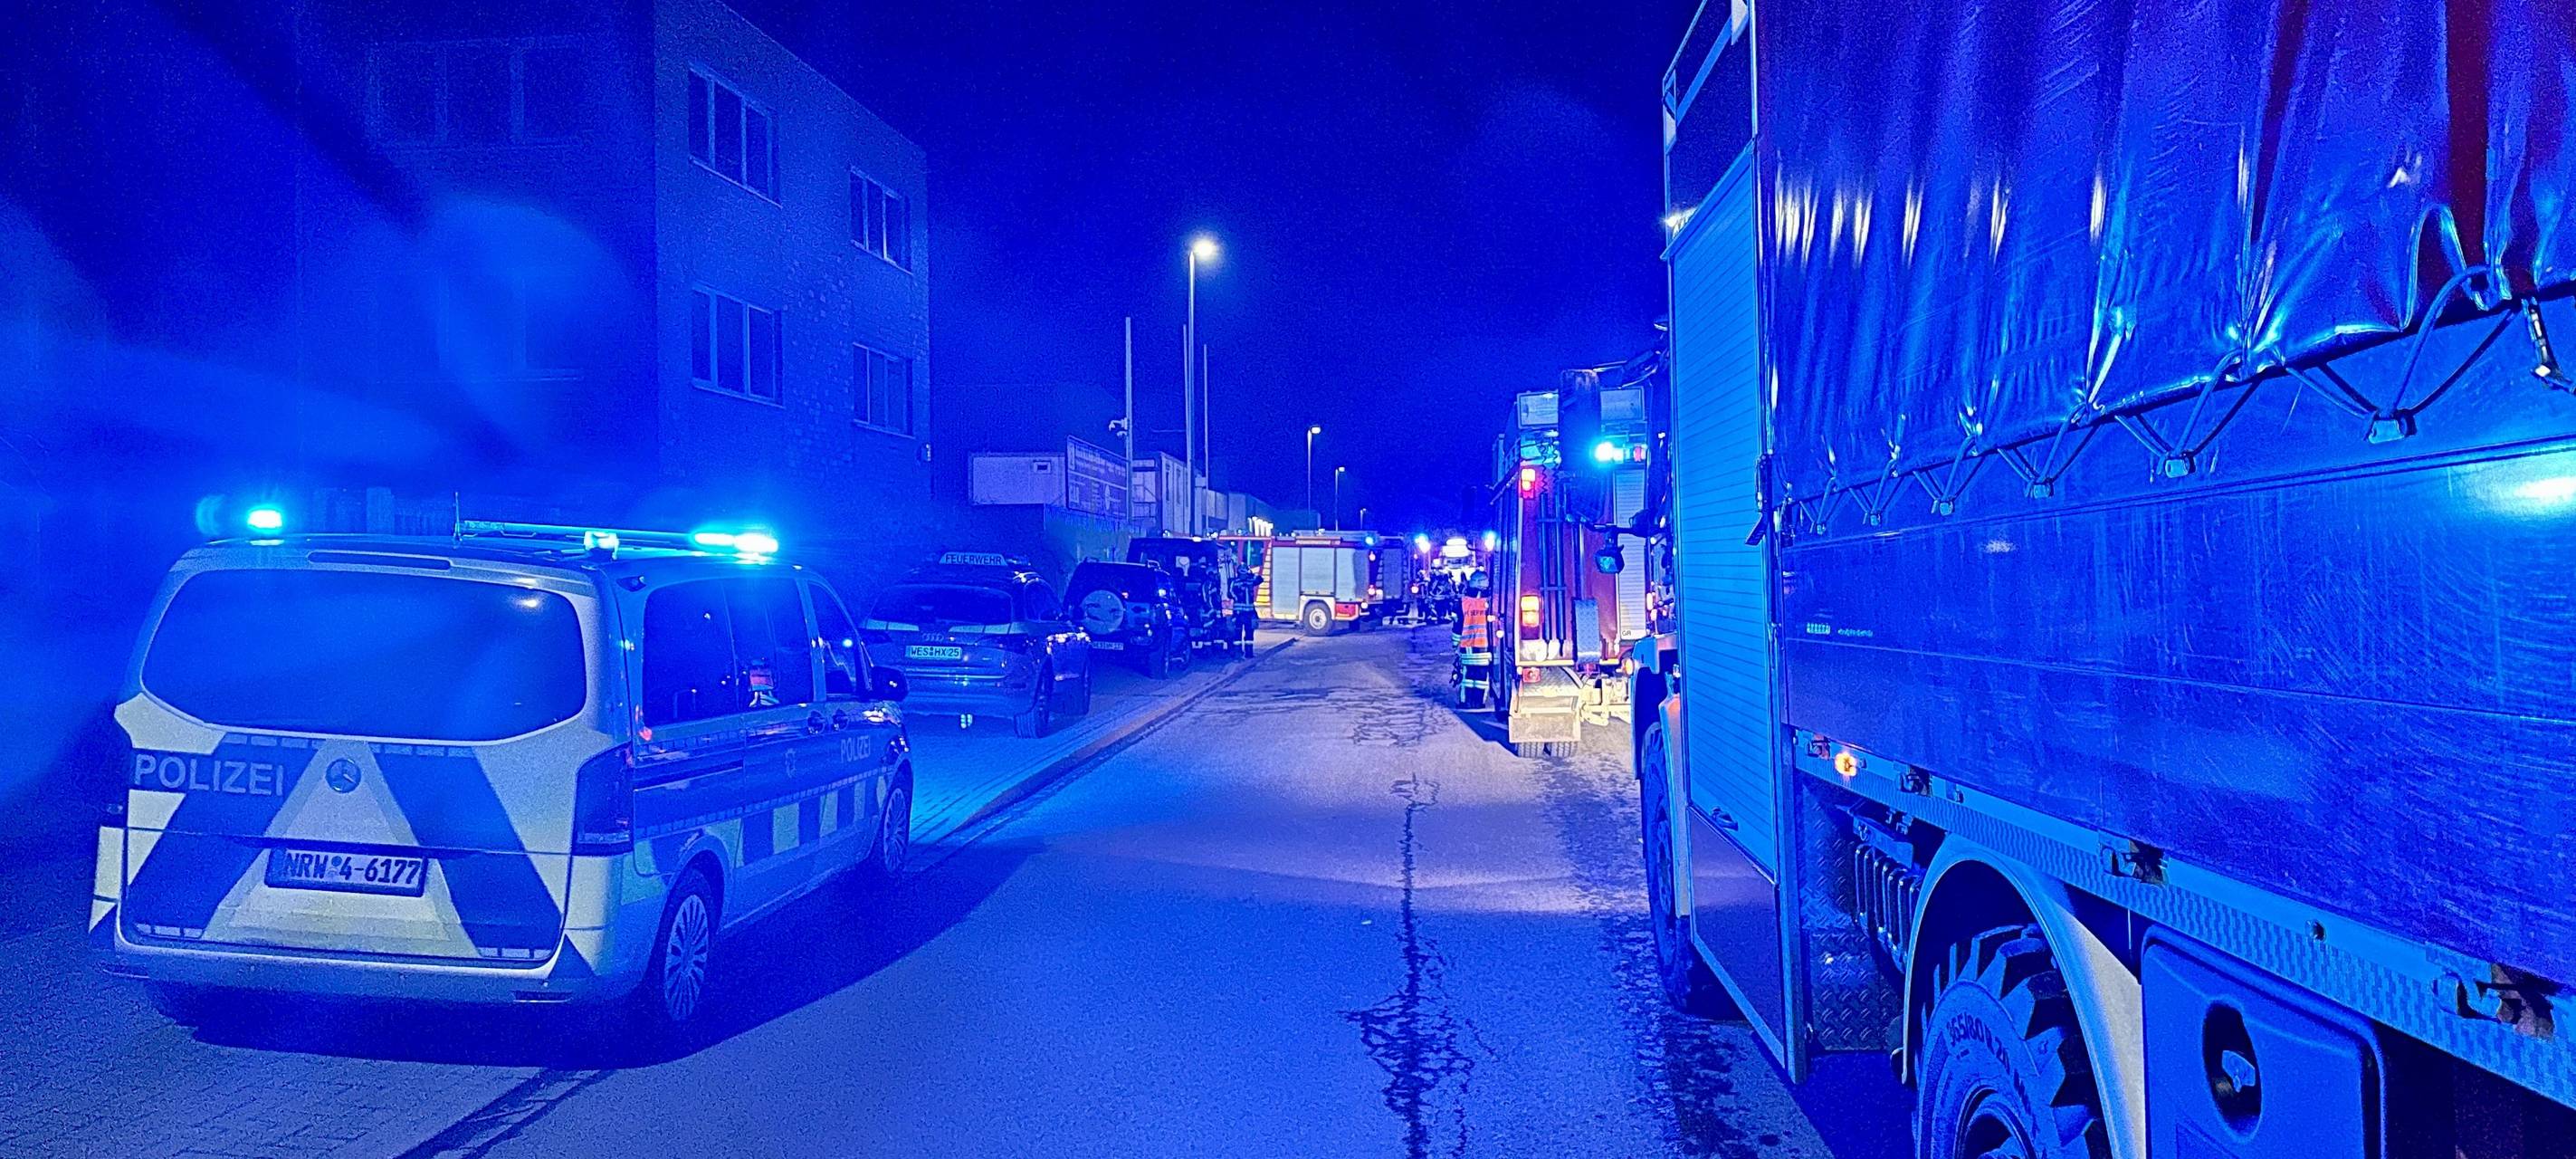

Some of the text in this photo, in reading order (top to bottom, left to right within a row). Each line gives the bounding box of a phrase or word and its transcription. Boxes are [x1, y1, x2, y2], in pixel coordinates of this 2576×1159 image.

[945, 554, 1002, 565] FEUERWEHR
[911, 647, 959, 657] WES HX 25
[840, 735, 871, 763] POLIZEI
[133, 753, 284, 797] POLIZEI
[285, 853, 421, 885] NRW 4-6177
